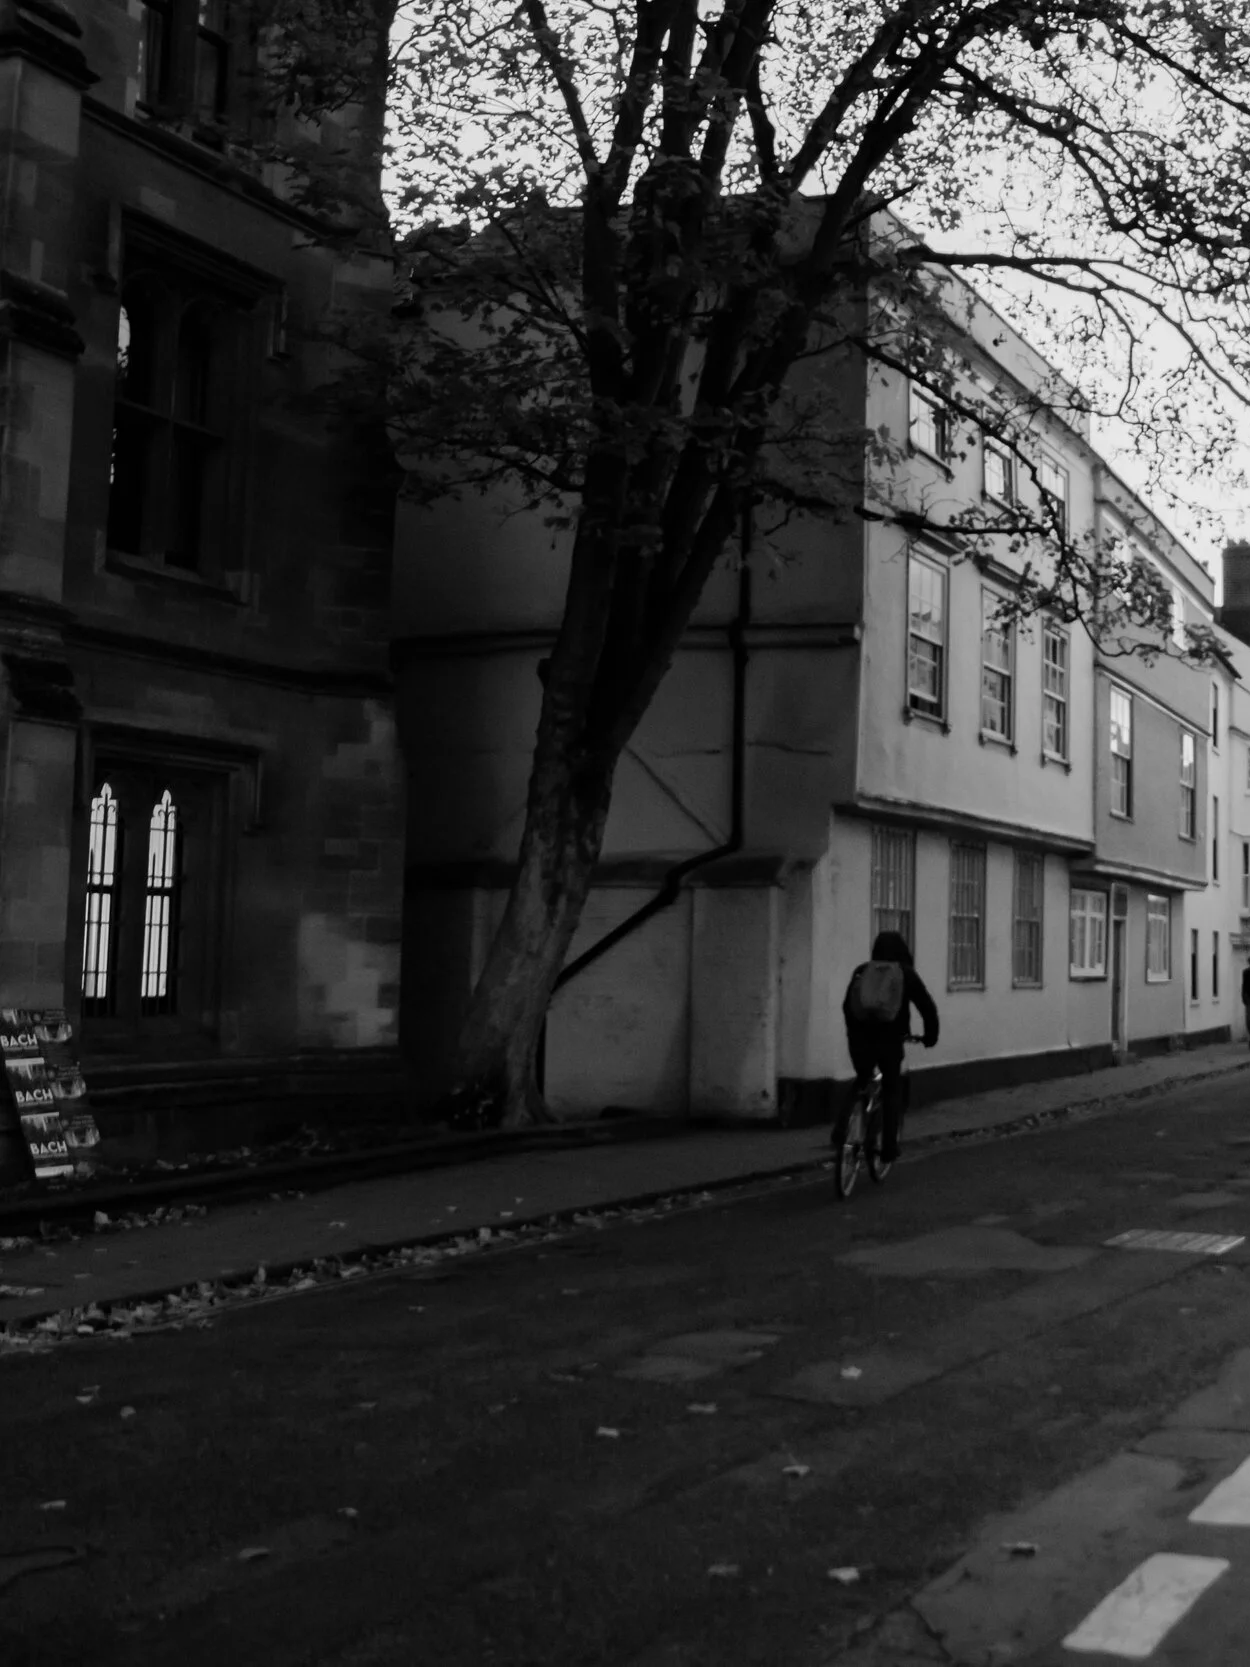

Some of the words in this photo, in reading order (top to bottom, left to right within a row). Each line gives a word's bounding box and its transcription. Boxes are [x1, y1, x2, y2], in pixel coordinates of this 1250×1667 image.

[0, 1034, 38, 1047] BACH
[16, 1089, 53, 1103] BACH
[31, 1141, 68, 1155] BACH
